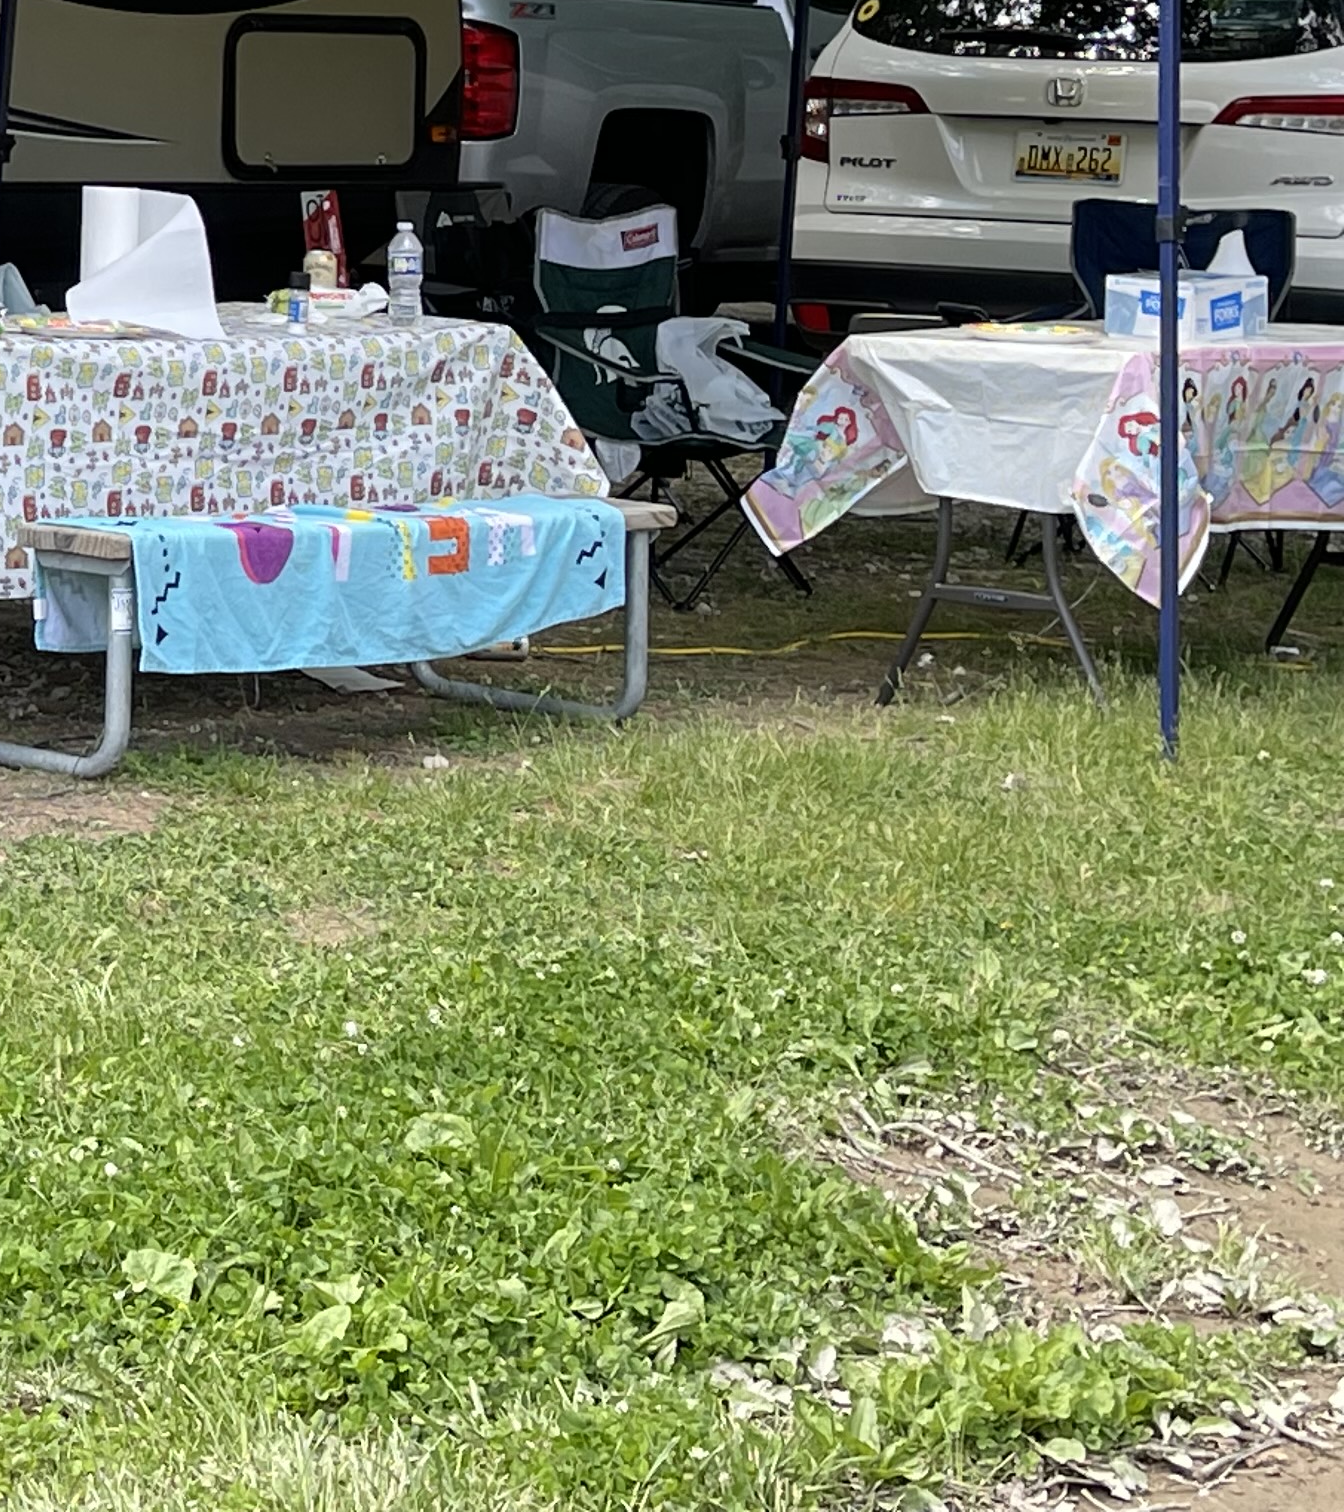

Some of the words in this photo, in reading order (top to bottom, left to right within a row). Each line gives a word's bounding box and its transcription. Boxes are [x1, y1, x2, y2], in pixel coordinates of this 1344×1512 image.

[839, 156, 897, 169] PILOT
[1027, 144, 1063, 172] DMX
[1076, 146, 1112, 173] 262
